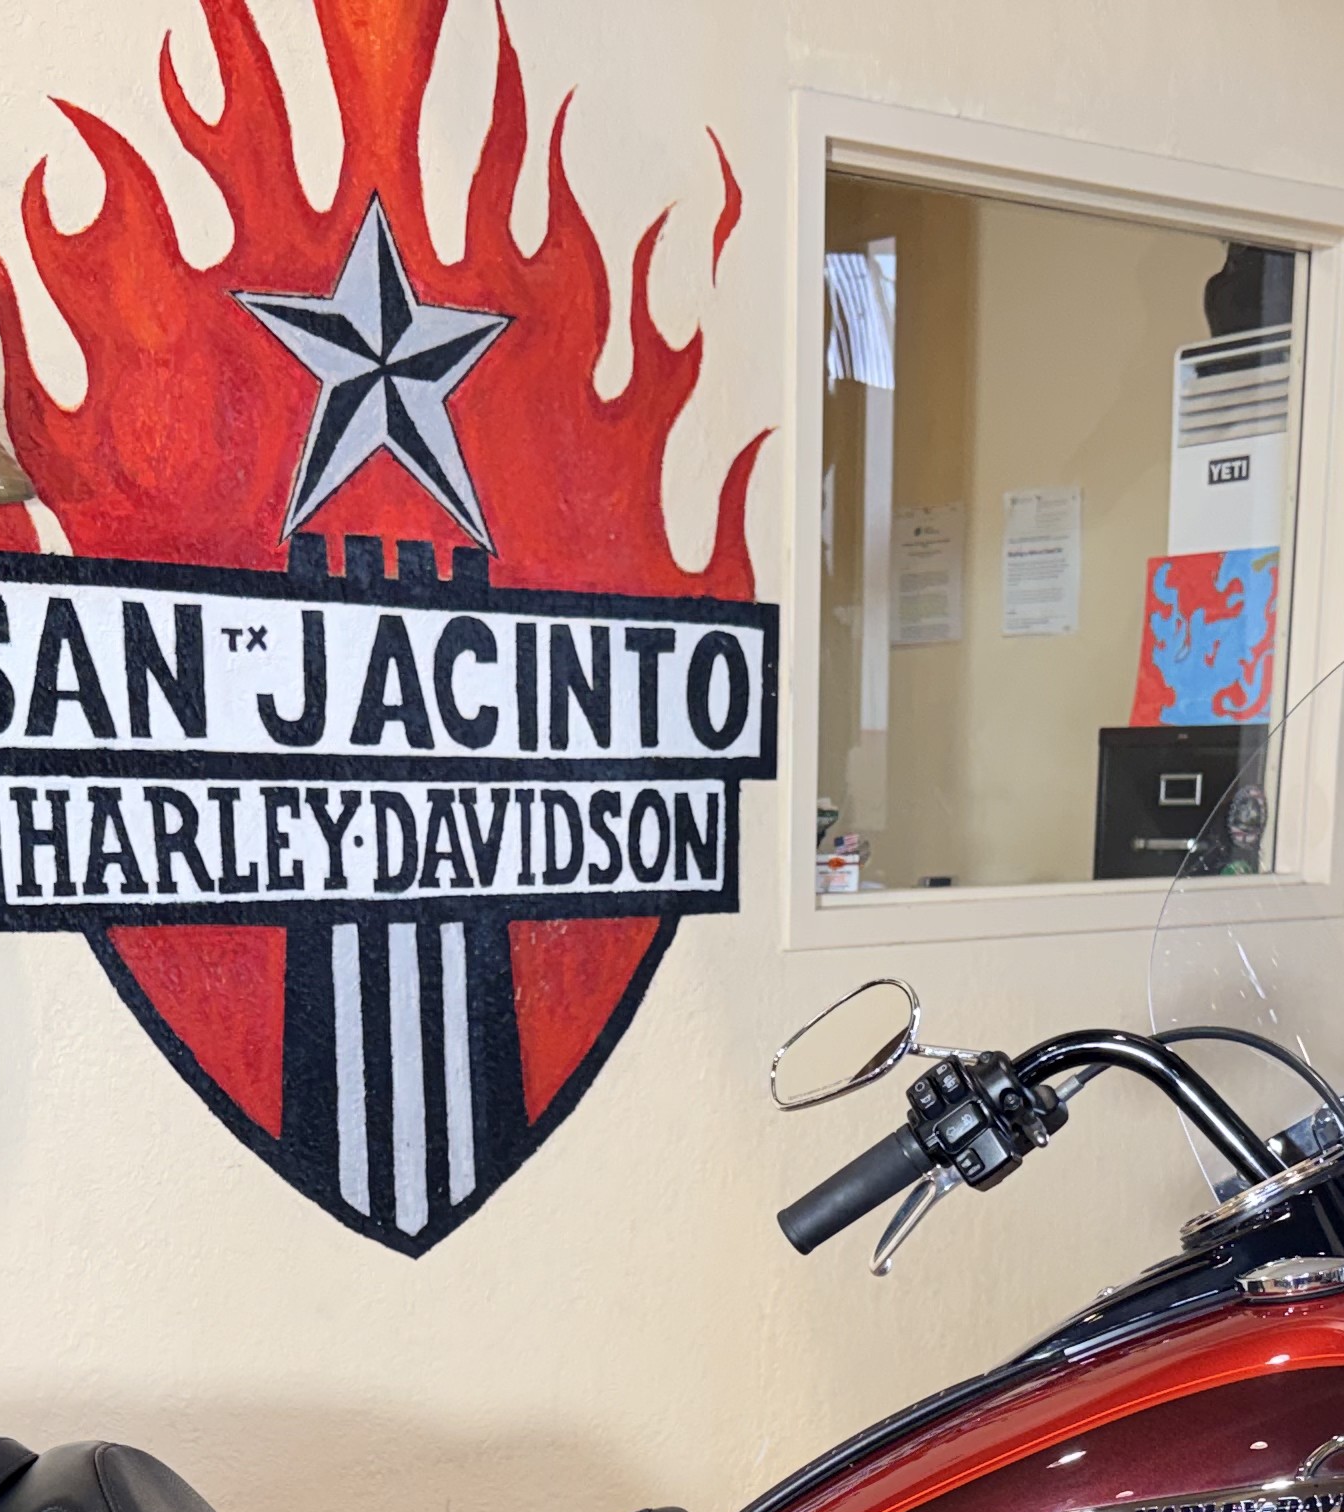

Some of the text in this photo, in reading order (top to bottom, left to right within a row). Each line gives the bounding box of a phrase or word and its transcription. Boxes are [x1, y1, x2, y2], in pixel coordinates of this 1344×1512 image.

[1210, 460, 1248, 482] YETI
[221, 626, 268, 653] TX
[256, 609, 750, 751] JACINTO
